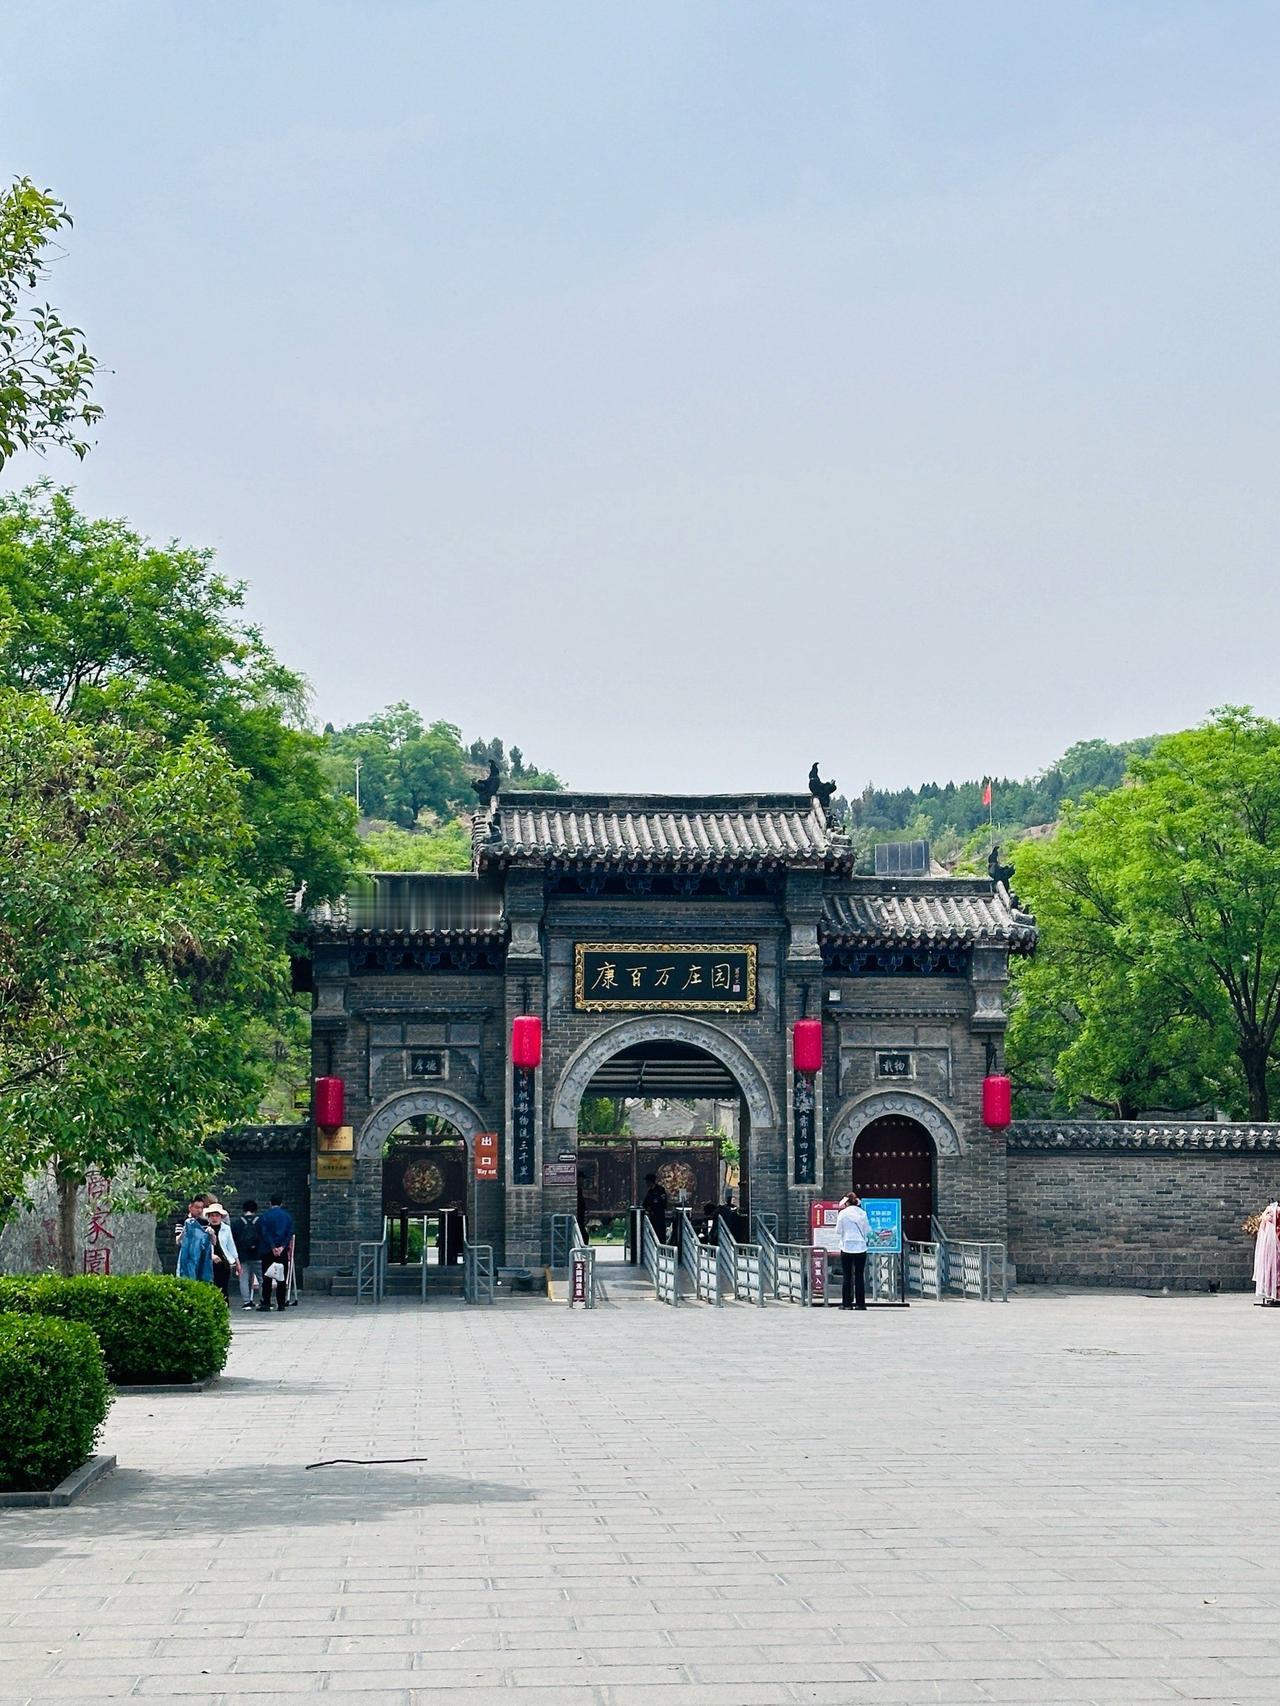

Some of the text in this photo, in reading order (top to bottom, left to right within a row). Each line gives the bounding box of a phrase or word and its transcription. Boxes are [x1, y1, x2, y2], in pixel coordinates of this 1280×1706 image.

[591, 962, 731, 990] 康百万庄园
[481, 1136, 492, 1165] 出口
